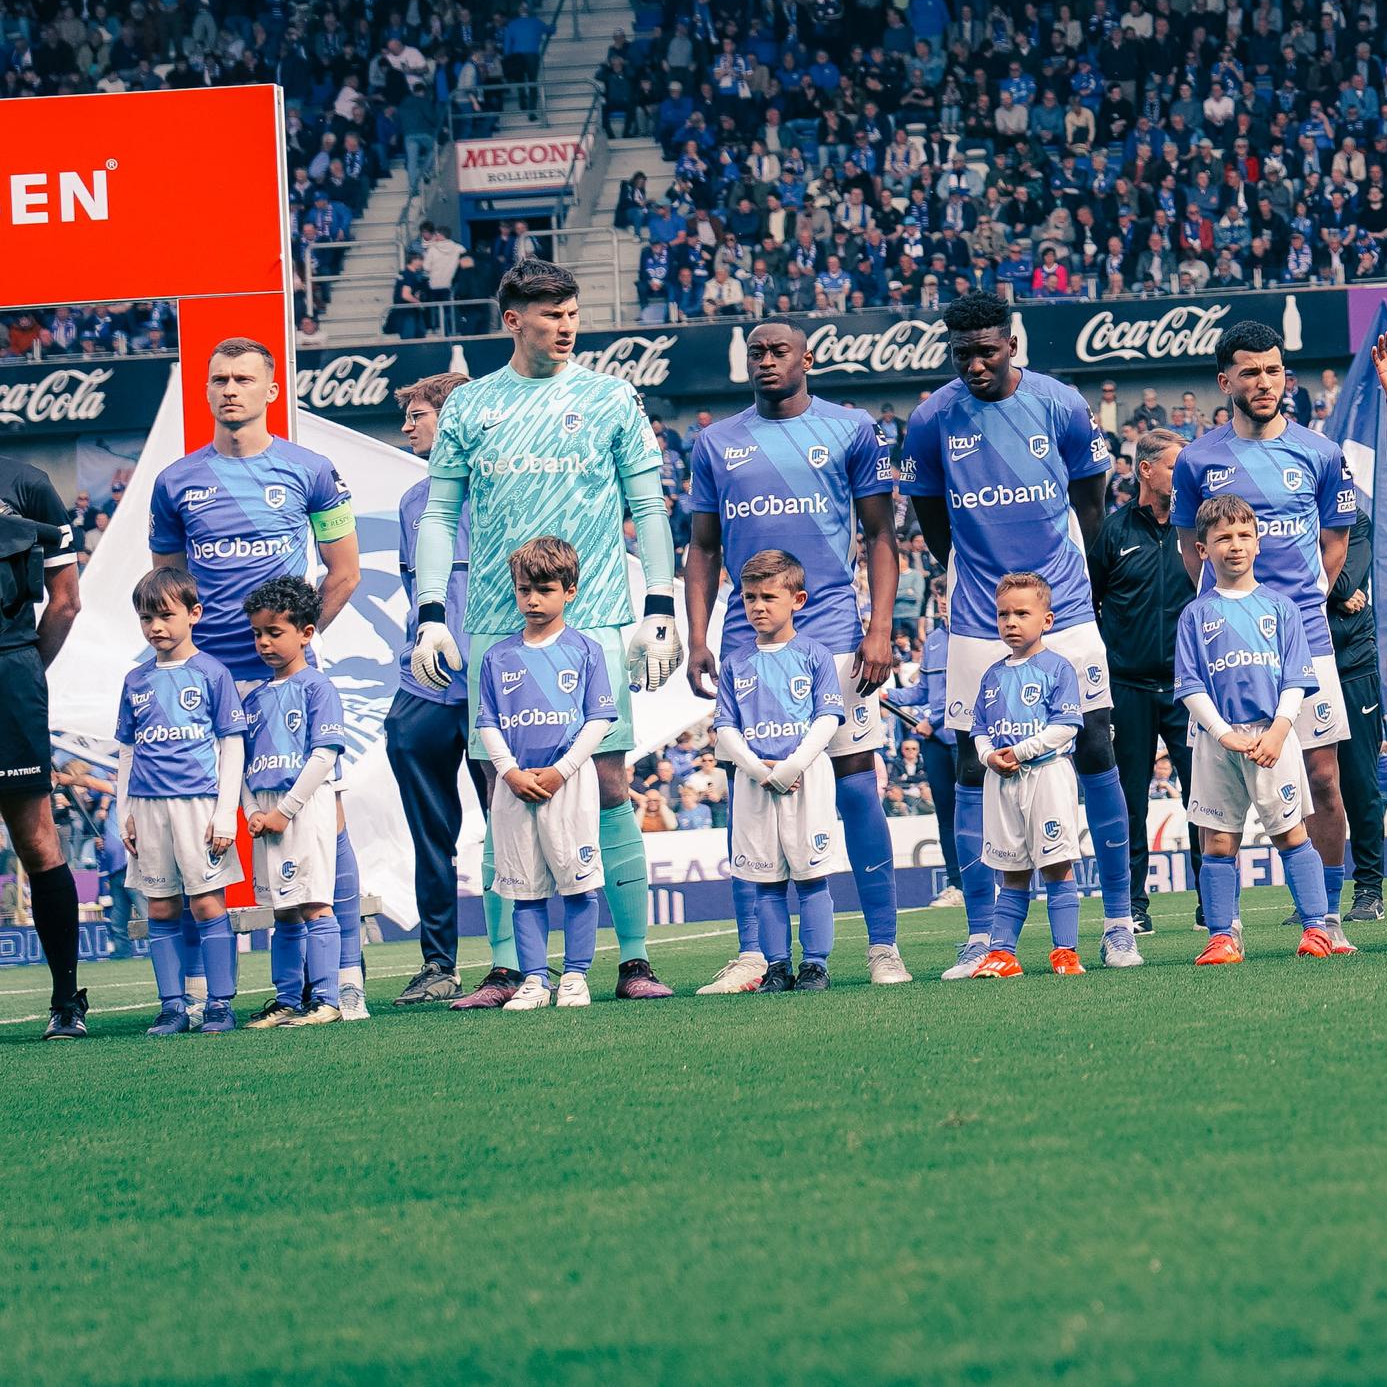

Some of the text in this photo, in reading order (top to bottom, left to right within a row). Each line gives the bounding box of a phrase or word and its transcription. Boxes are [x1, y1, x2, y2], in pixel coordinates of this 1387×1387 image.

[947, 437, 975, 451] itzu
[1207, 474, 1231, 489] itzu
[1260, 516, 1308, 537] bank
[7, 766, 41, 777] PATRICK
